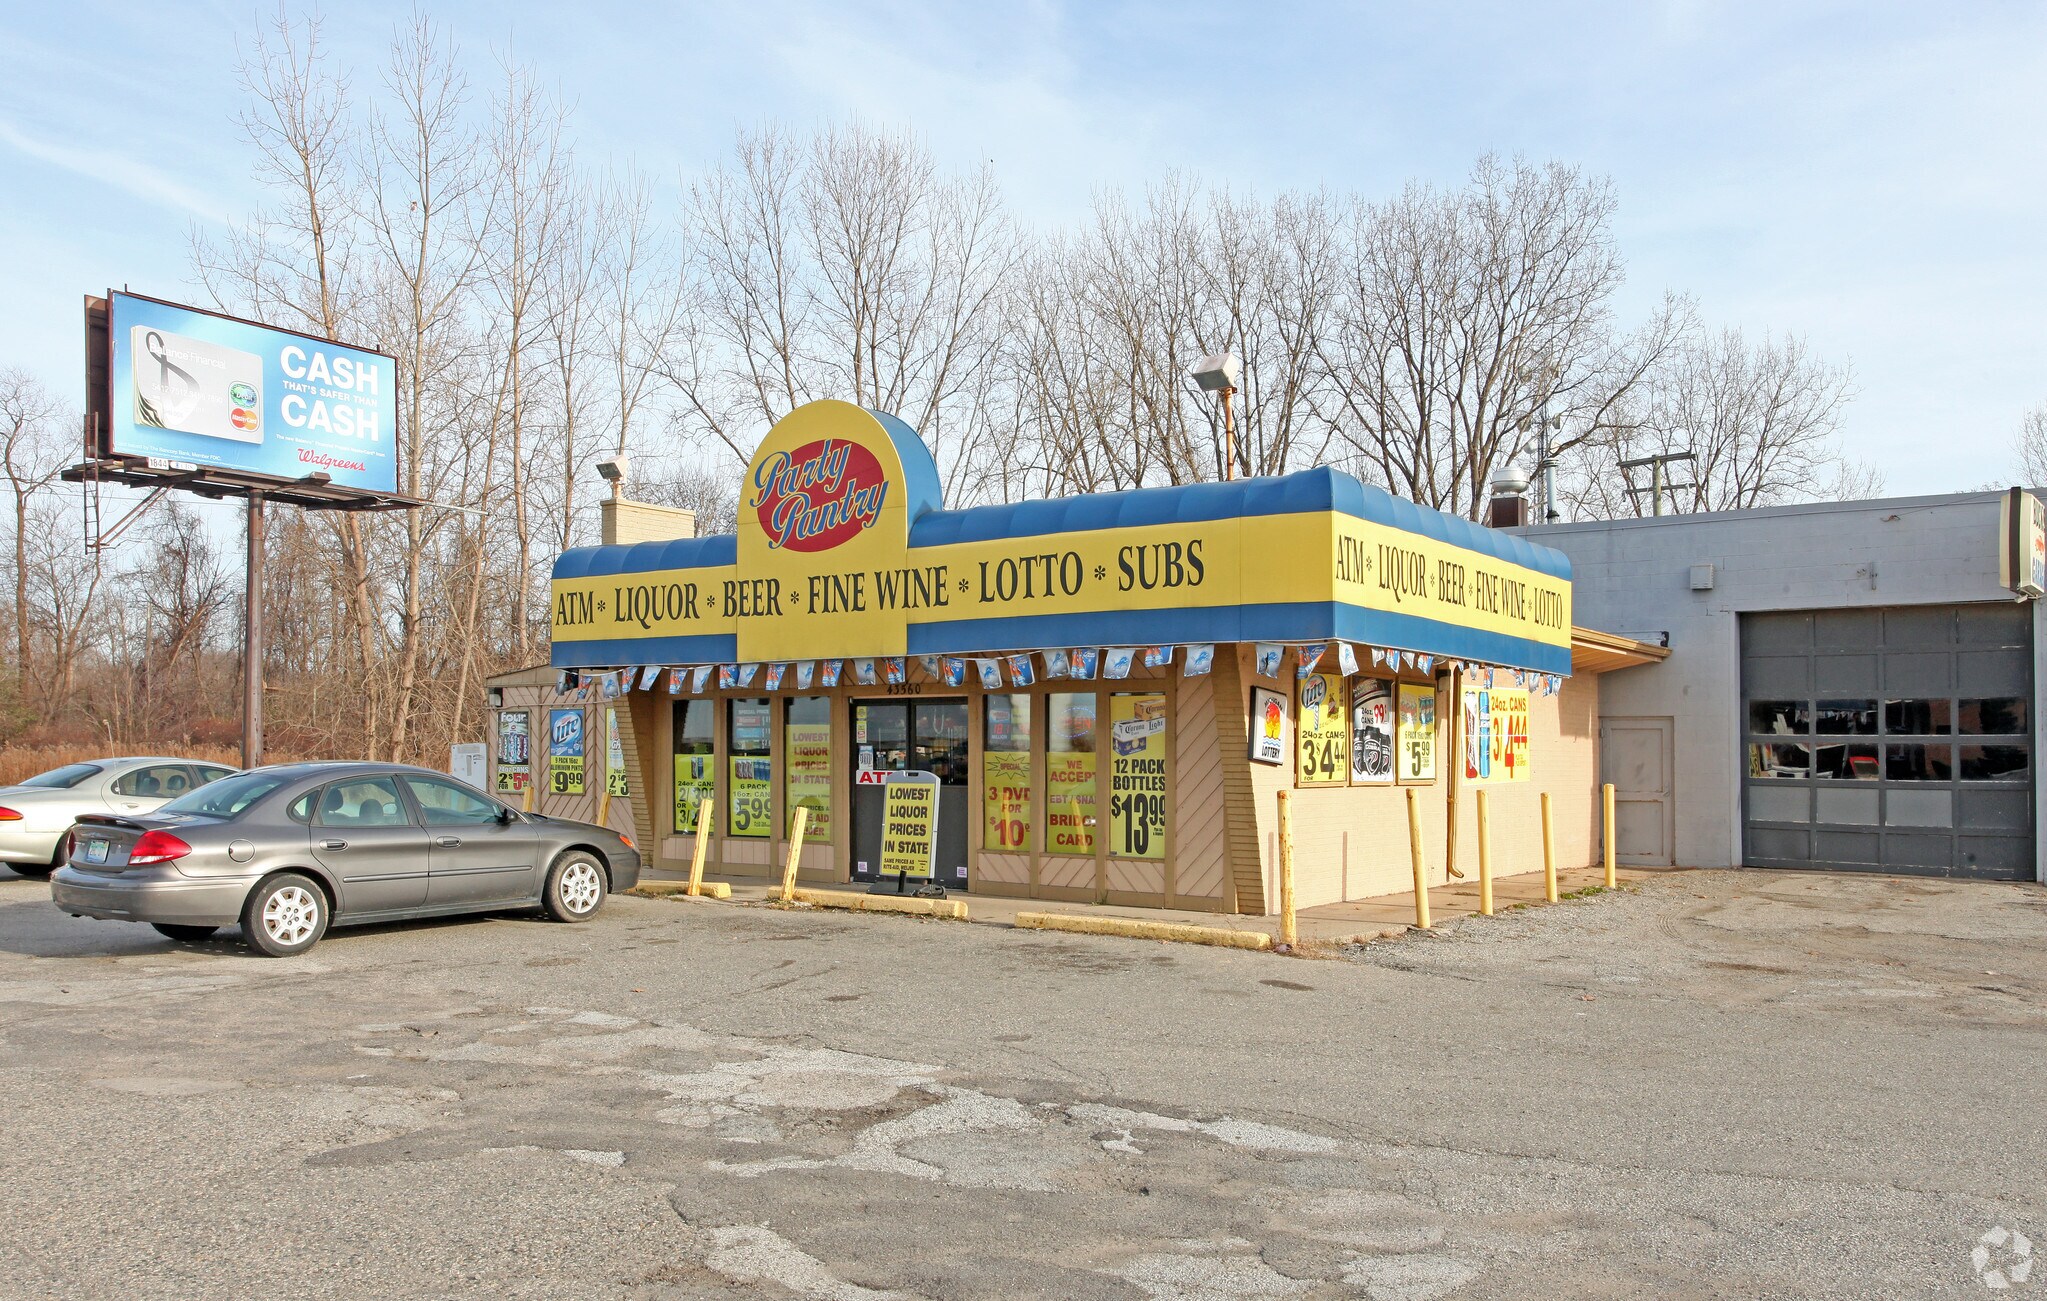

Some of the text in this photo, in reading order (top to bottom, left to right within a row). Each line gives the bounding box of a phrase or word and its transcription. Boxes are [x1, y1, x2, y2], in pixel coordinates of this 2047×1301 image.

[280, 345, 378, 395] CASH
[283, 380, 377, 407] THAT'S SAFER THAN
[281, 394, 379, 442] CASH
[150, 458, 167, 468] 1844
[298, 447, 366, 470] Walgreens
[750, 438, 852, 507] Party
[768, 479, 889, 549] Pantry
[555, 539, 1204, 629] ATM LIQUOR BEER FINE WINE LOTTO SUBS
[1336, 534, 1563, 630] ATM LIQUOR BEER FINE WINE LOTTO
[887, 683, 921, 695] 43560
[1305, 681, 1323, 708] Lite
[1491, 696, 1527, 712] 24oz. CANS
[1125, 724, 1145, 734] Corona
[1149, 720, 1163, 731] Light
[1361, 716, 1374, 725] CANS
[556, 718, 579, 743] Lite
[793, 733, 829, 742] LOWEST
[1302, 730, 1345, 739] 24oz CANS
[794, 747, 828, 757] LIQUOR
[1261, 745, 1280, 759] LOTTERY
[1302, 740, 1317, 776] 3
[795, 761, 828, 770] PRICES
[1066, 760, 1083, 770] WE
[1113, 759, 1165, 775] 12 PACK
[498, 773, 508, 784] 2
[609, 774, 617, 788] 2
[791, 774, 831, 785] IN STATE
[859, 771, 893, 784] AT
[1112, 775, 1166, 792] BOTTLES
[889, 788, 931, 801] LOWEST
[988, 786, 998, 801] 3
[1050, 794, 1067, 804] EBT
[890, 805, 928, 819] LIQUOR
[1001, 804, 1022, 813] FOR
[815, 814, 830, 823] AID
[889, 823, 927, 836] PRICES
[1056, 833, 1093, 846] CARD
[884, 840, 929, 855] IN STATE
